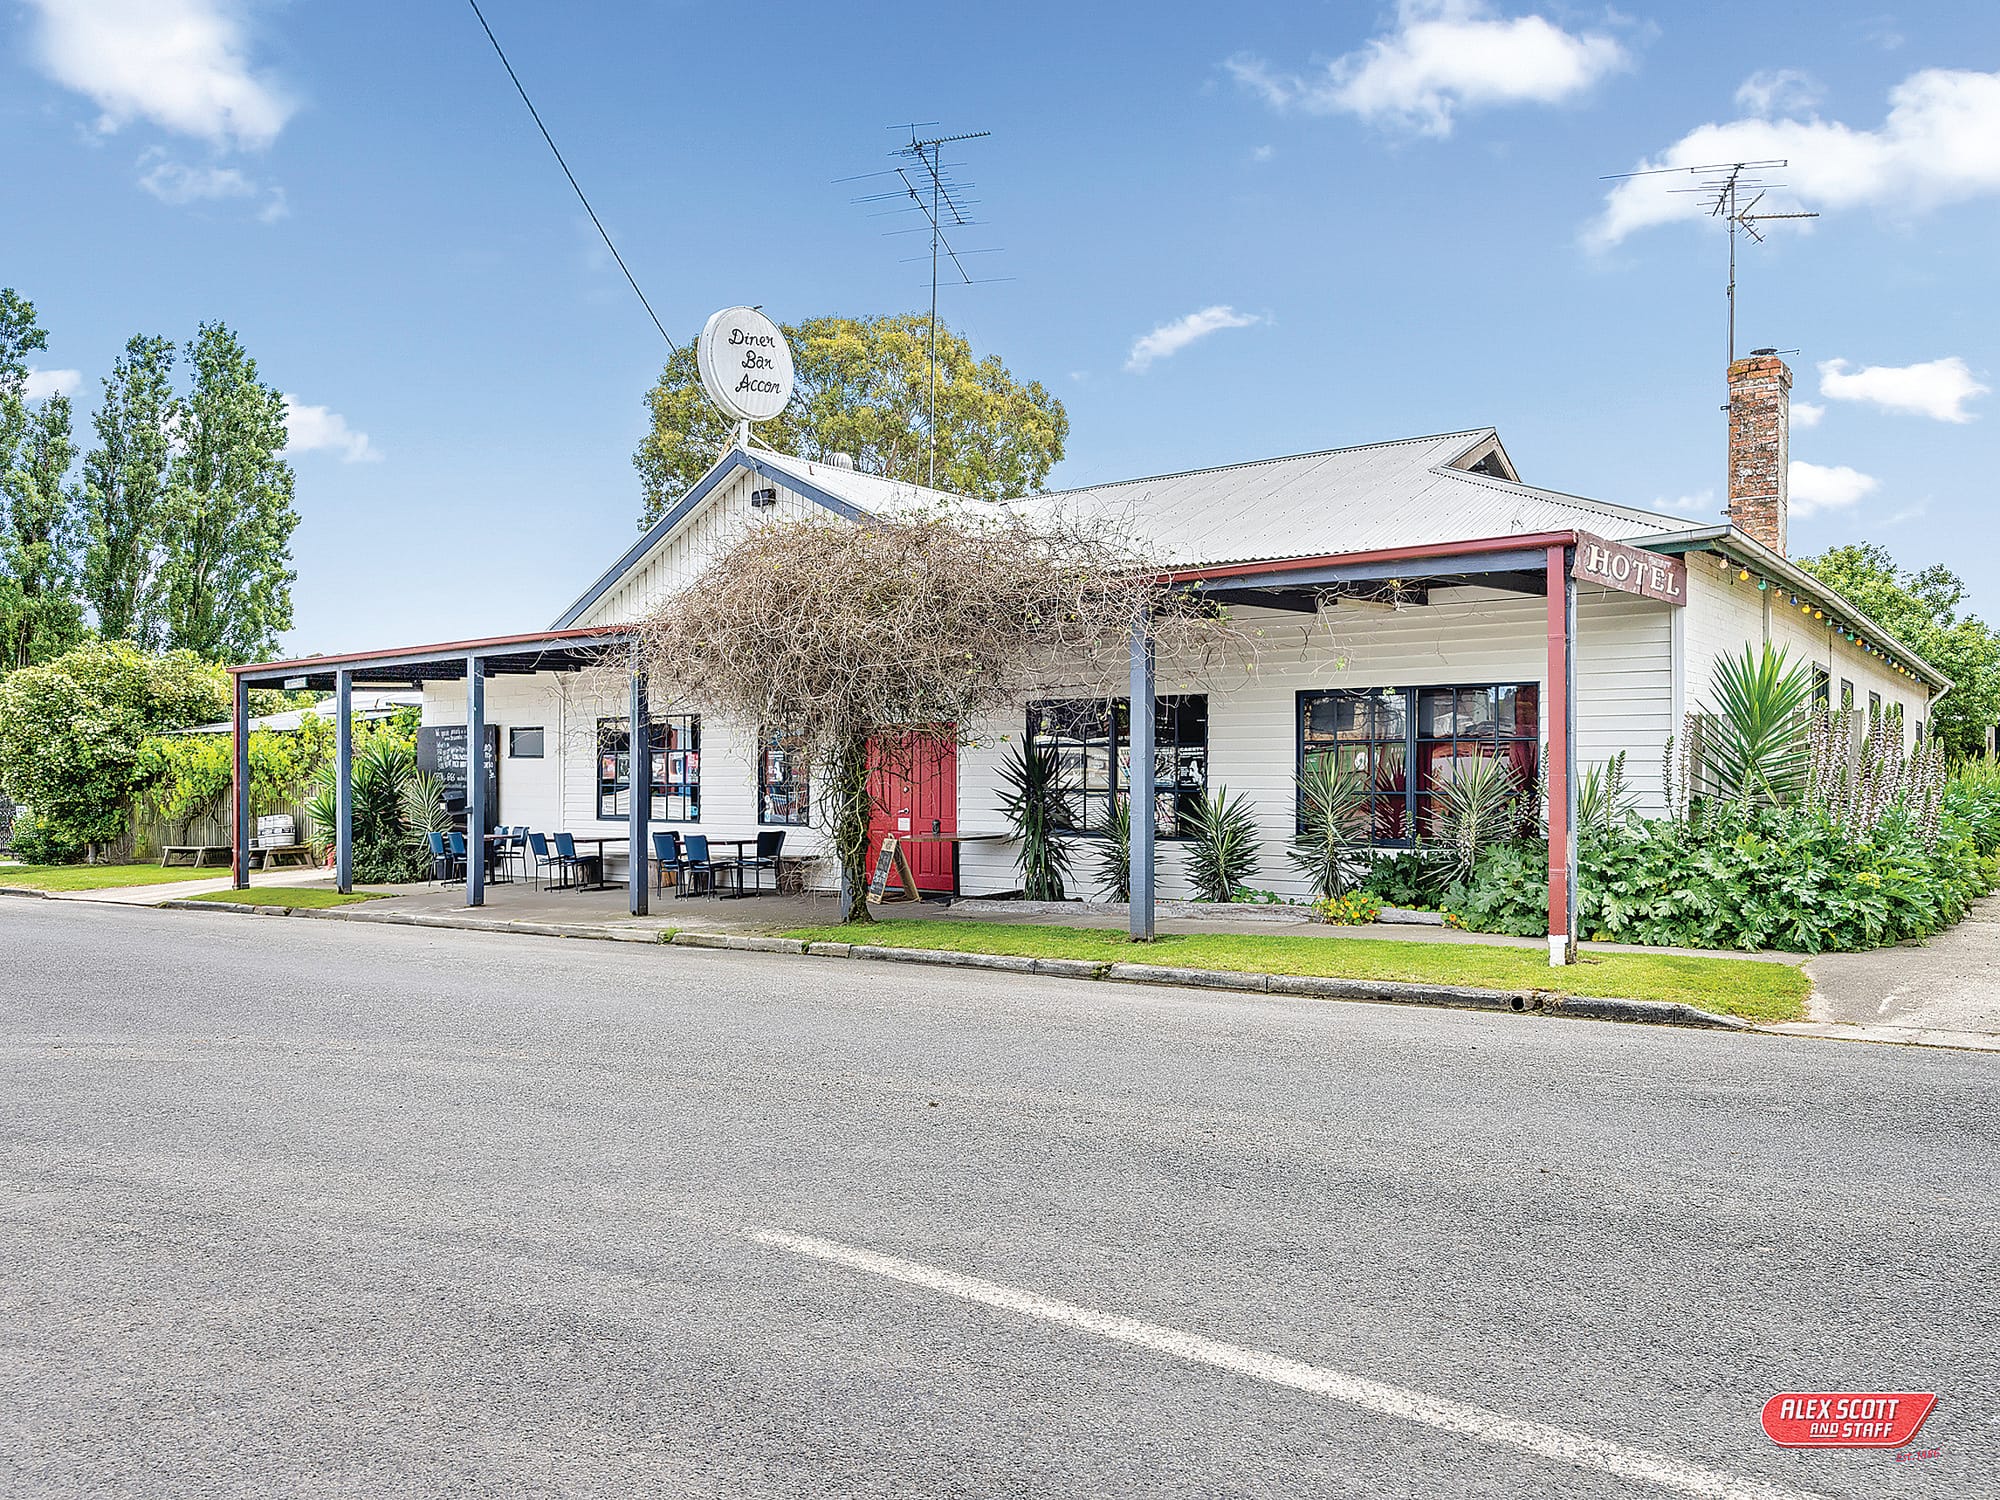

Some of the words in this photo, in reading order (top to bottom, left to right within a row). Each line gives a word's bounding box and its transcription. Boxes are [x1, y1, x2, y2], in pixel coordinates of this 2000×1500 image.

[728, 328, 776, 348] Diner
[741, 350, 774, 370] Bar
[1586, 543, 1680, 597] HOTEL
